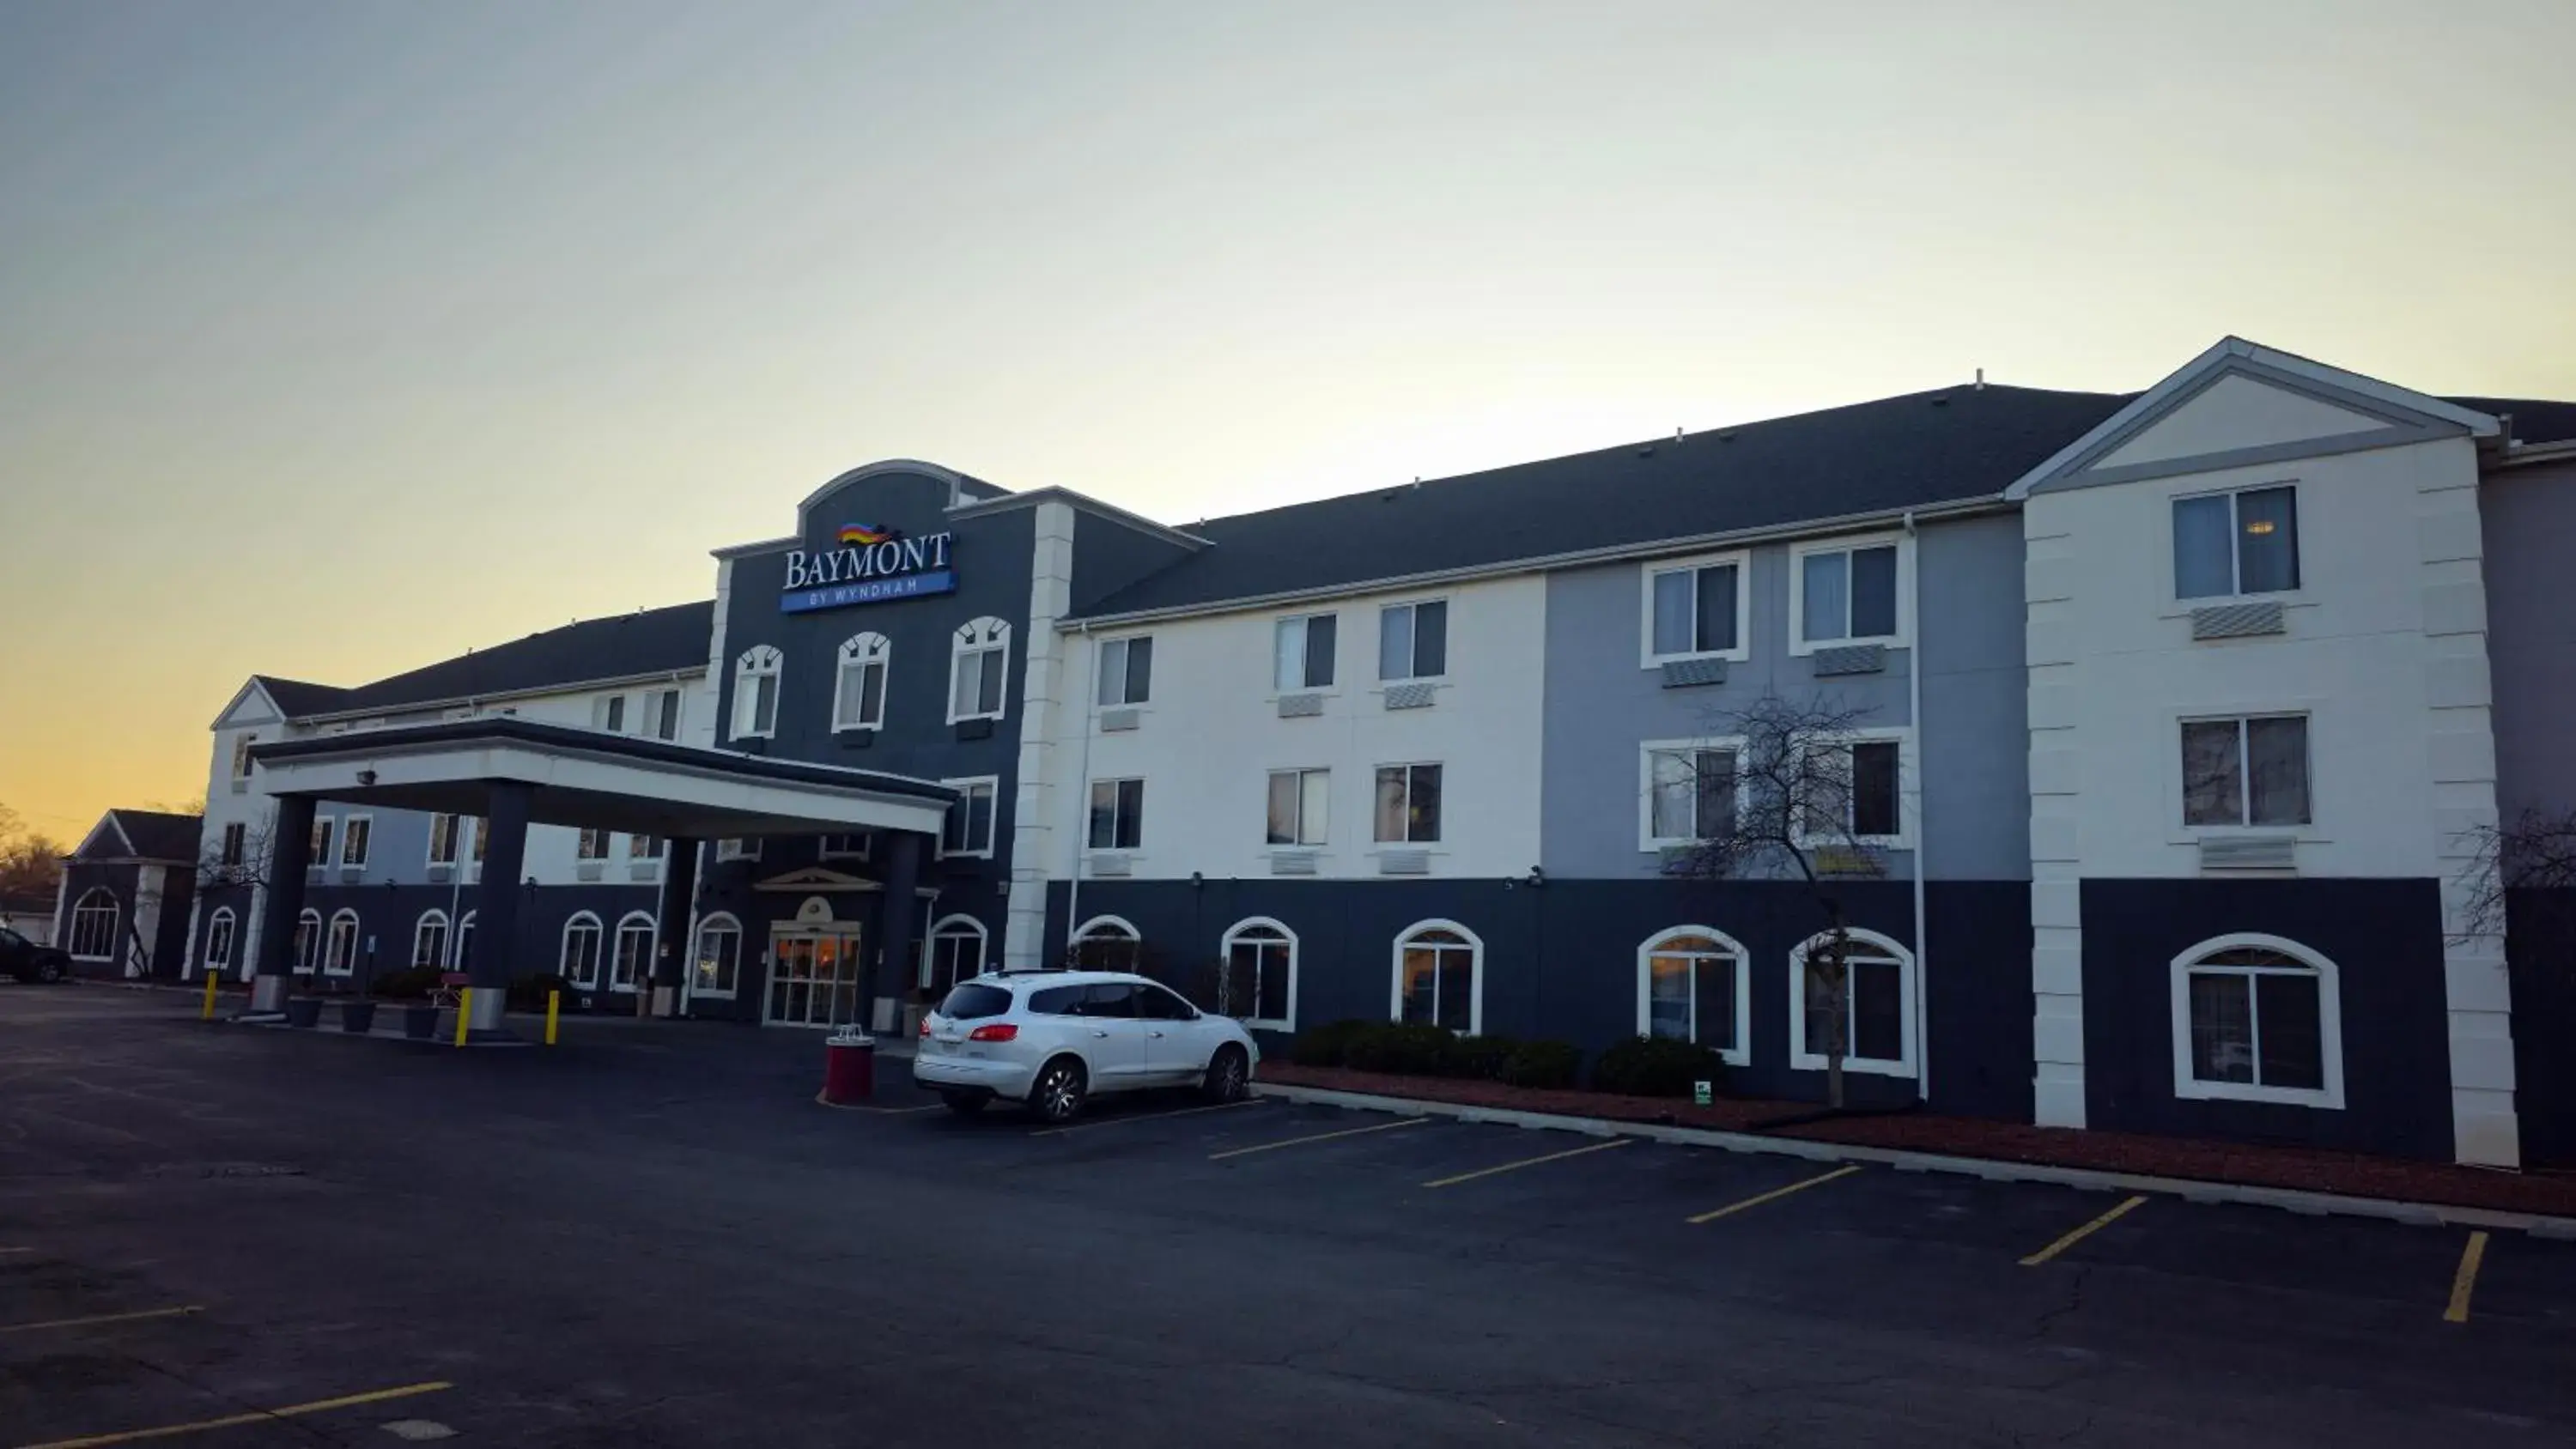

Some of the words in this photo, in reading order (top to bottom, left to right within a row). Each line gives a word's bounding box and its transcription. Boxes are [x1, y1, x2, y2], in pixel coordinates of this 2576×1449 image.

[782, 531, 951, 590] BAYMONT
[809, 593, 827, 605] BY
[835, 579, 917, 602] WYNDHAM
